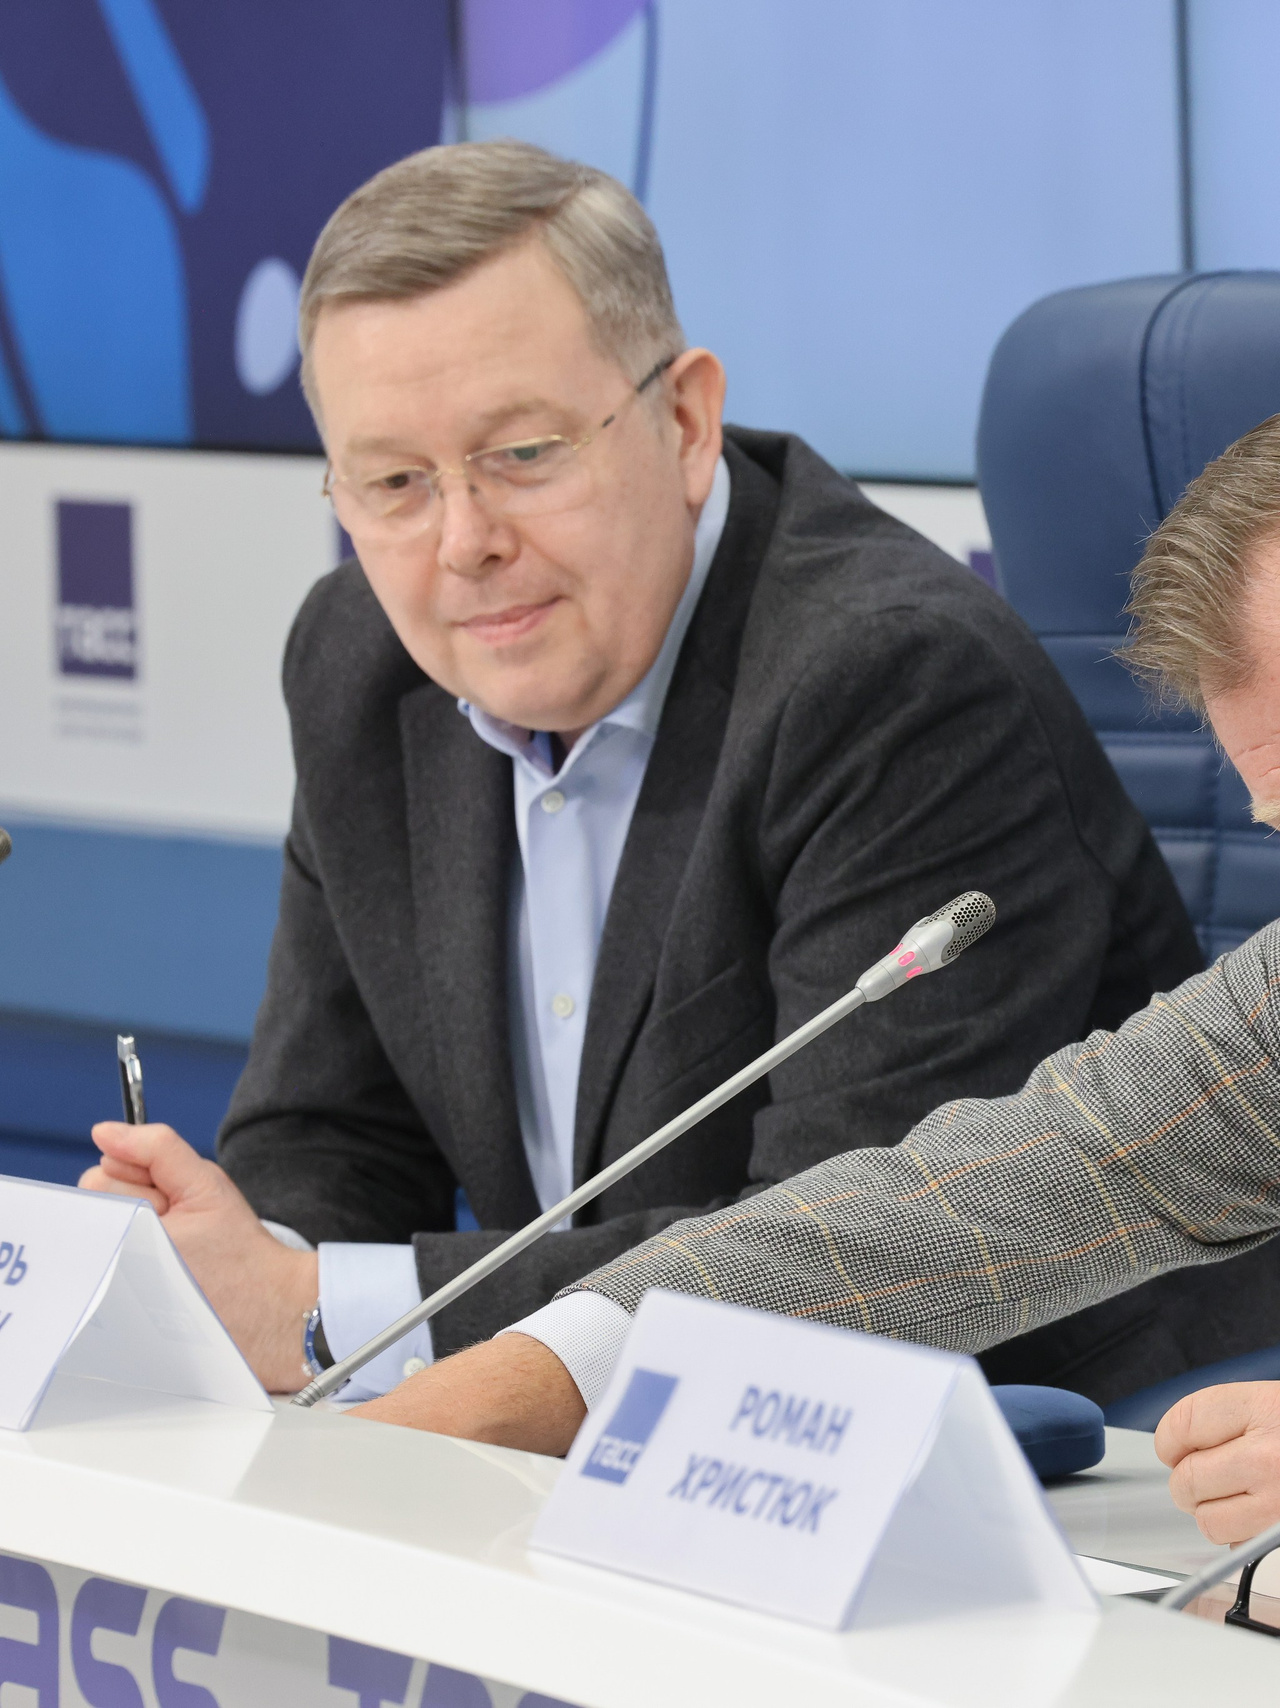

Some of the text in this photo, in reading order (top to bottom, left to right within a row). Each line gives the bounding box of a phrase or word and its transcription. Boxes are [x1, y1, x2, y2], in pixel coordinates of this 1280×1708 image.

[0, 1241, 28, 1286] РЬ
[729, 1385, 852, 1456] РОМАН
[667, 1453, 839, 1533] ХРИСТЮК
